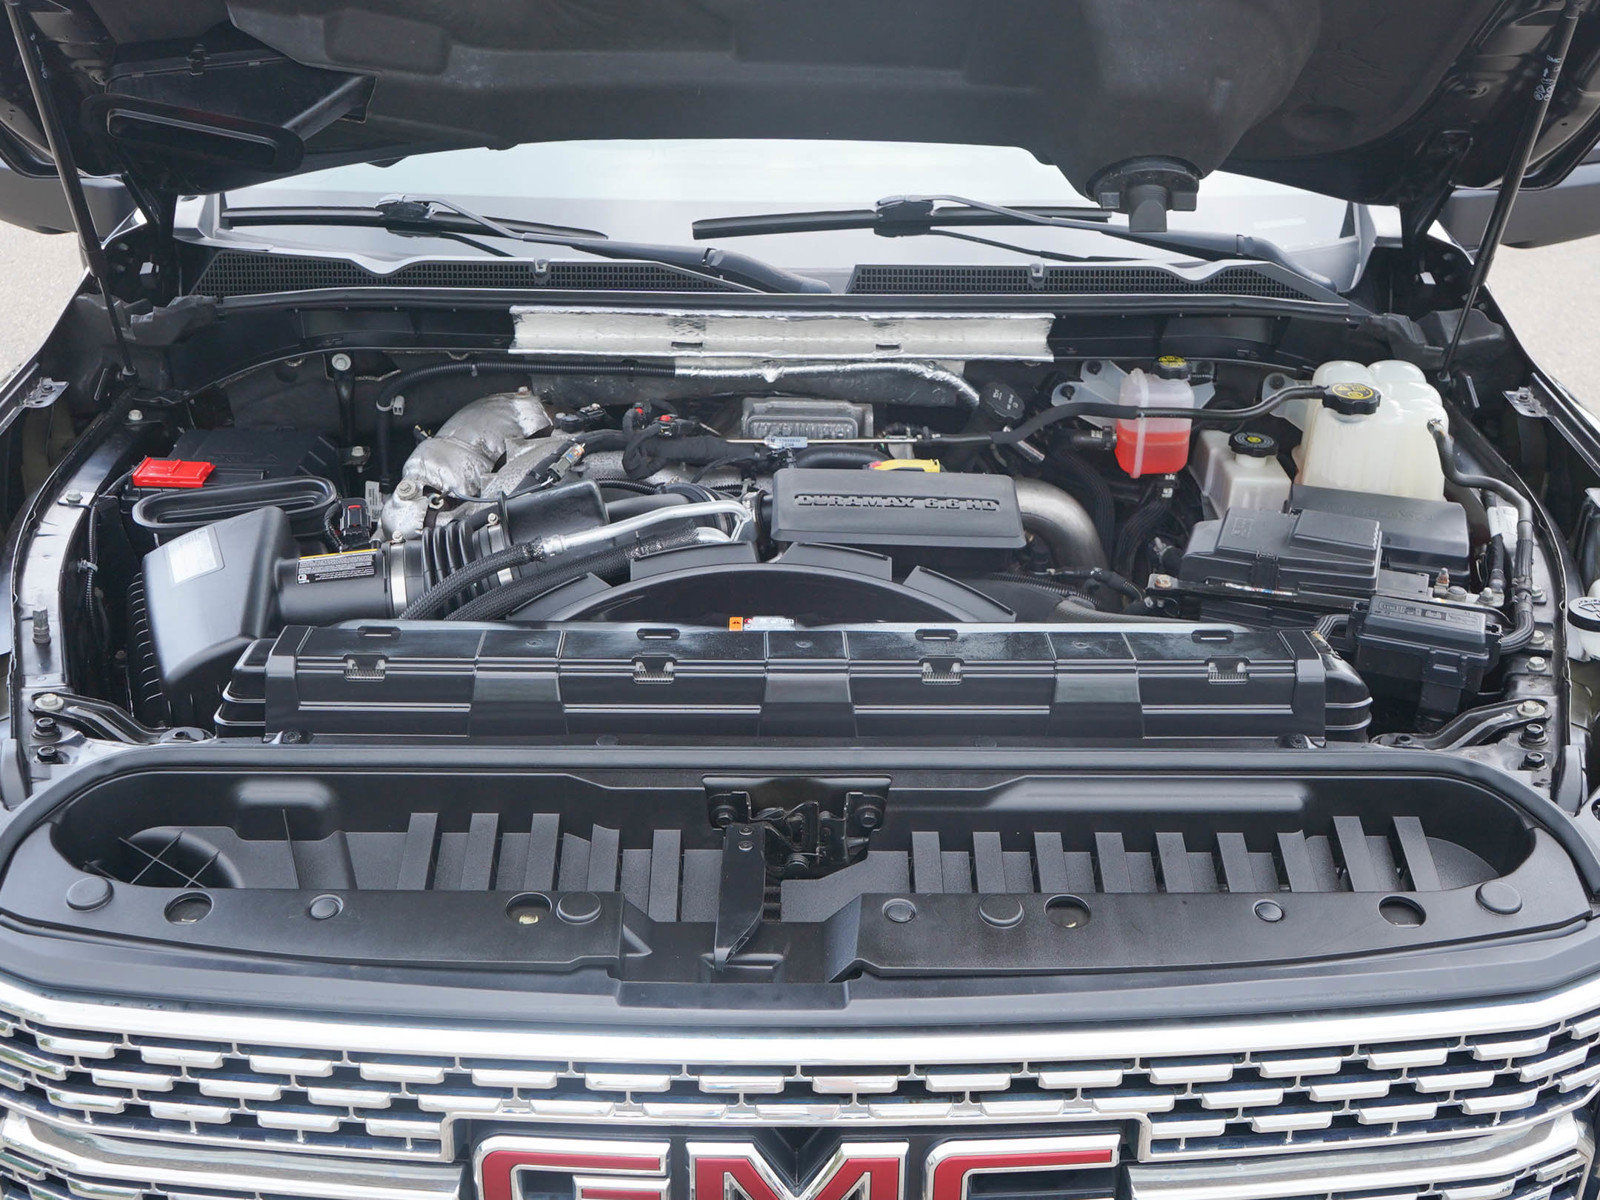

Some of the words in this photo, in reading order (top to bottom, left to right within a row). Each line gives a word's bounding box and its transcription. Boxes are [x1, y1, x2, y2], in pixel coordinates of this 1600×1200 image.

[795, 494, 915, 509] DURAMAX
[924, 497, 960, 510] 6.6
[966, 499, 1000, 512] HD
